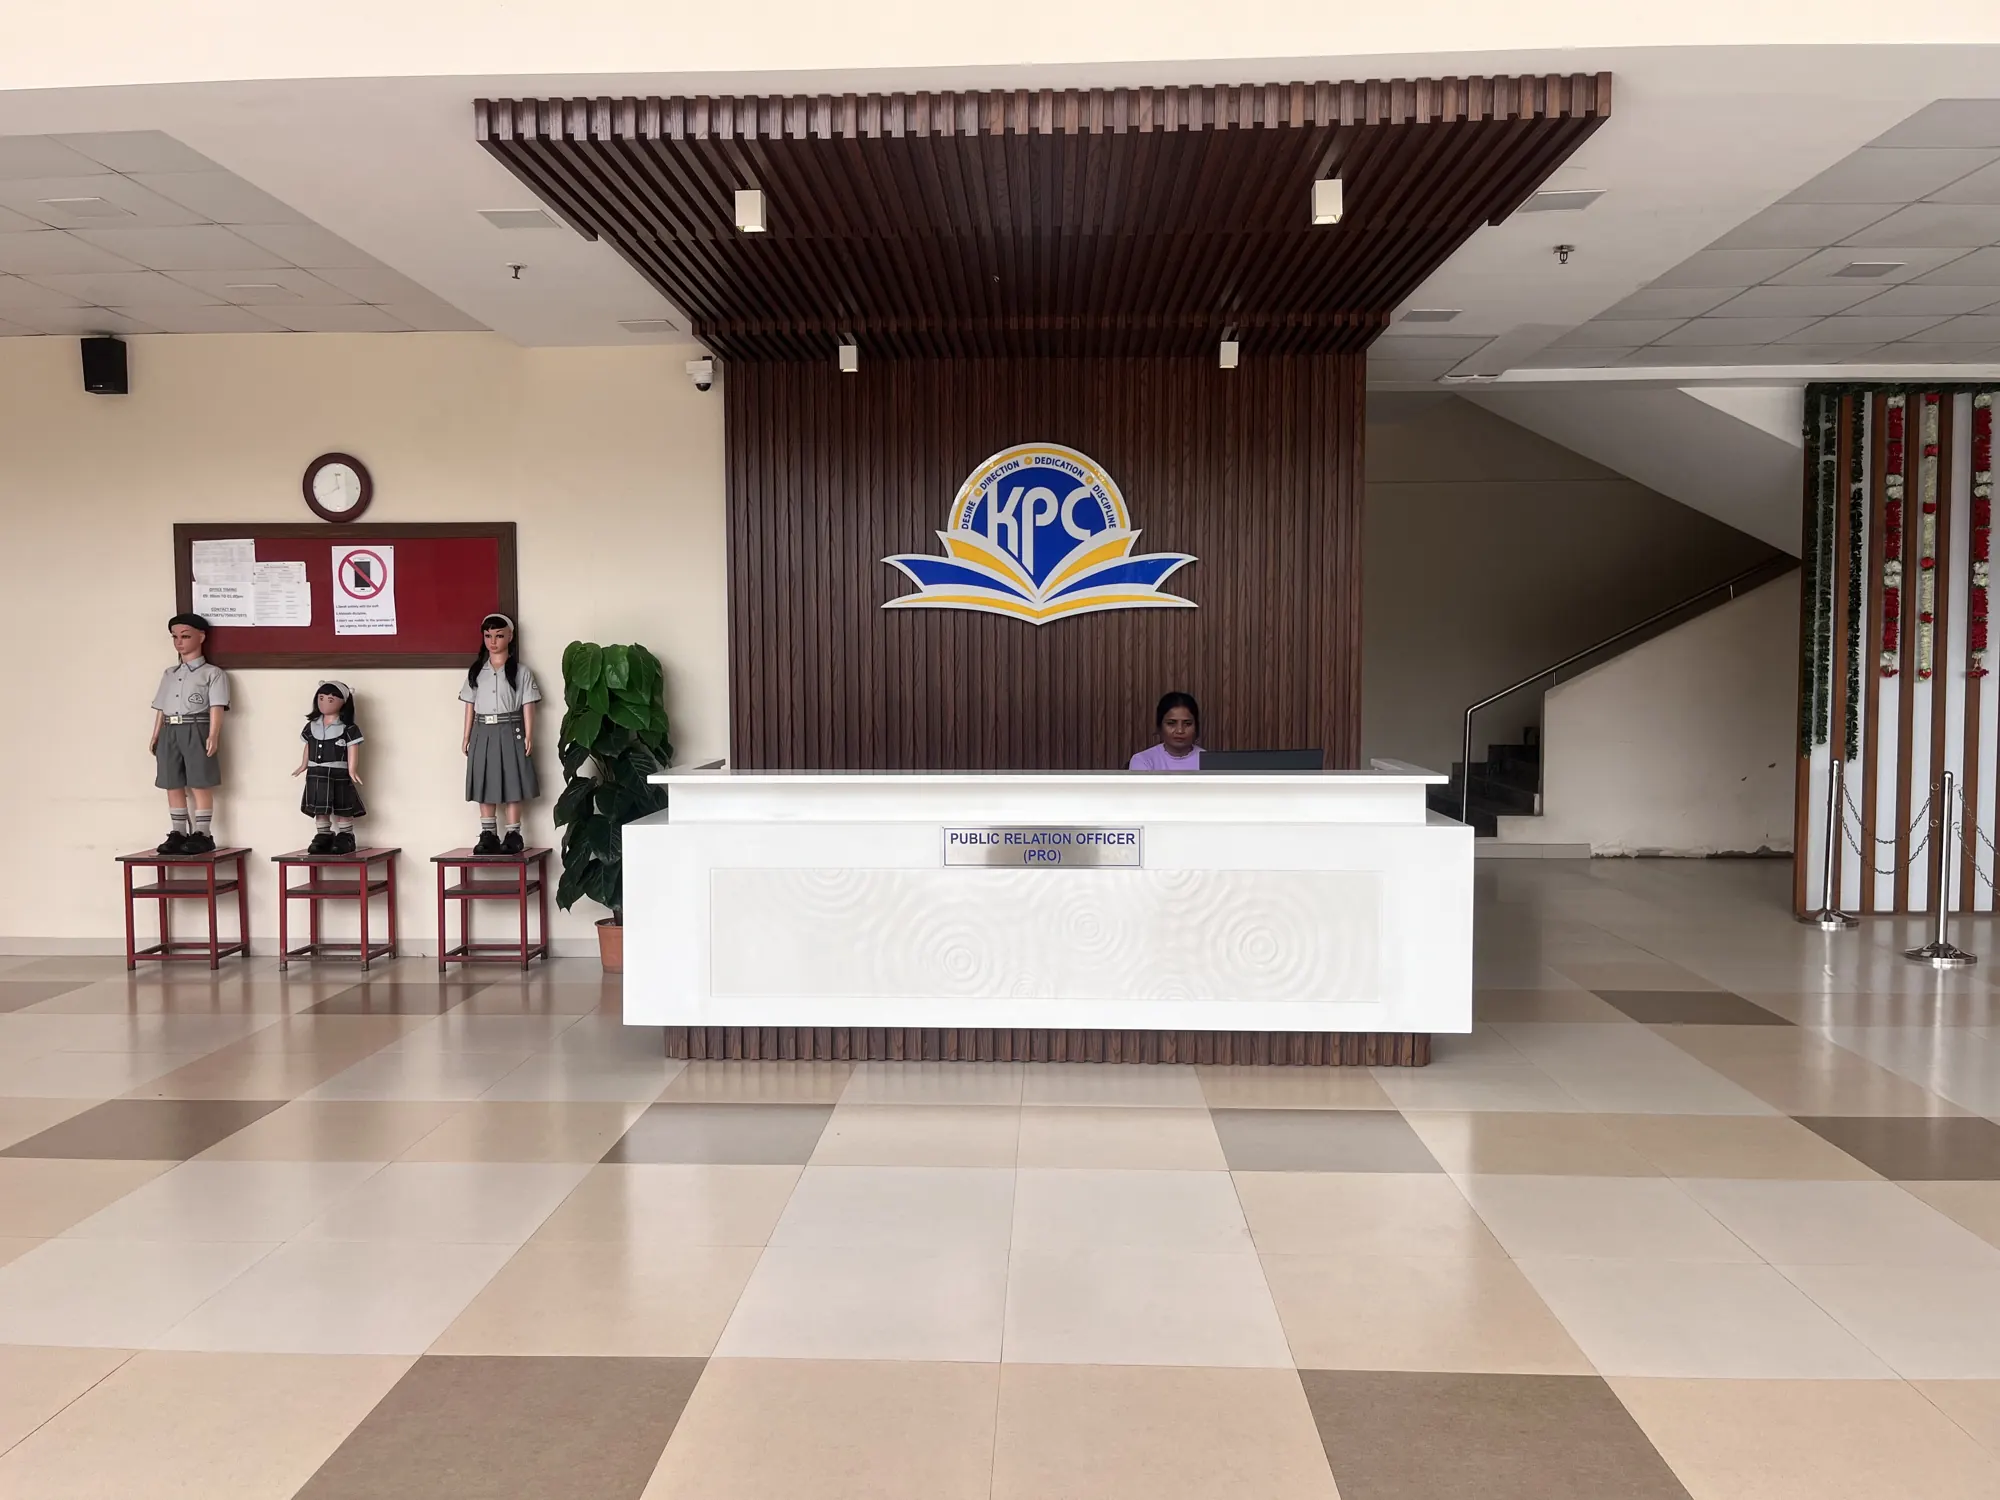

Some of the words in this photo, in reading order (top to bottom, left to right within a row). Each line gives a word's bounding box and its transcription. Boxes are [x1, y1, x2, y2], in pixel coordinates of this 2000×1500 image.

[961, 500, 977, 530] DESIRE
[979, 459, 1020, 491] DIRECTION
[1034, 456, 1085, 478] DEDICATION
[1092, 484, 1117, 529] DISCIPLINE
[987, 483, 1092, 576] KPC
[950, 832, 1000, 845] PUBLIC
[1004, 832, 1071, 845] RELATION
[1076, 832, 1135, 845] OFFICER
[1023, 849, 1061, 864] (PRO)
